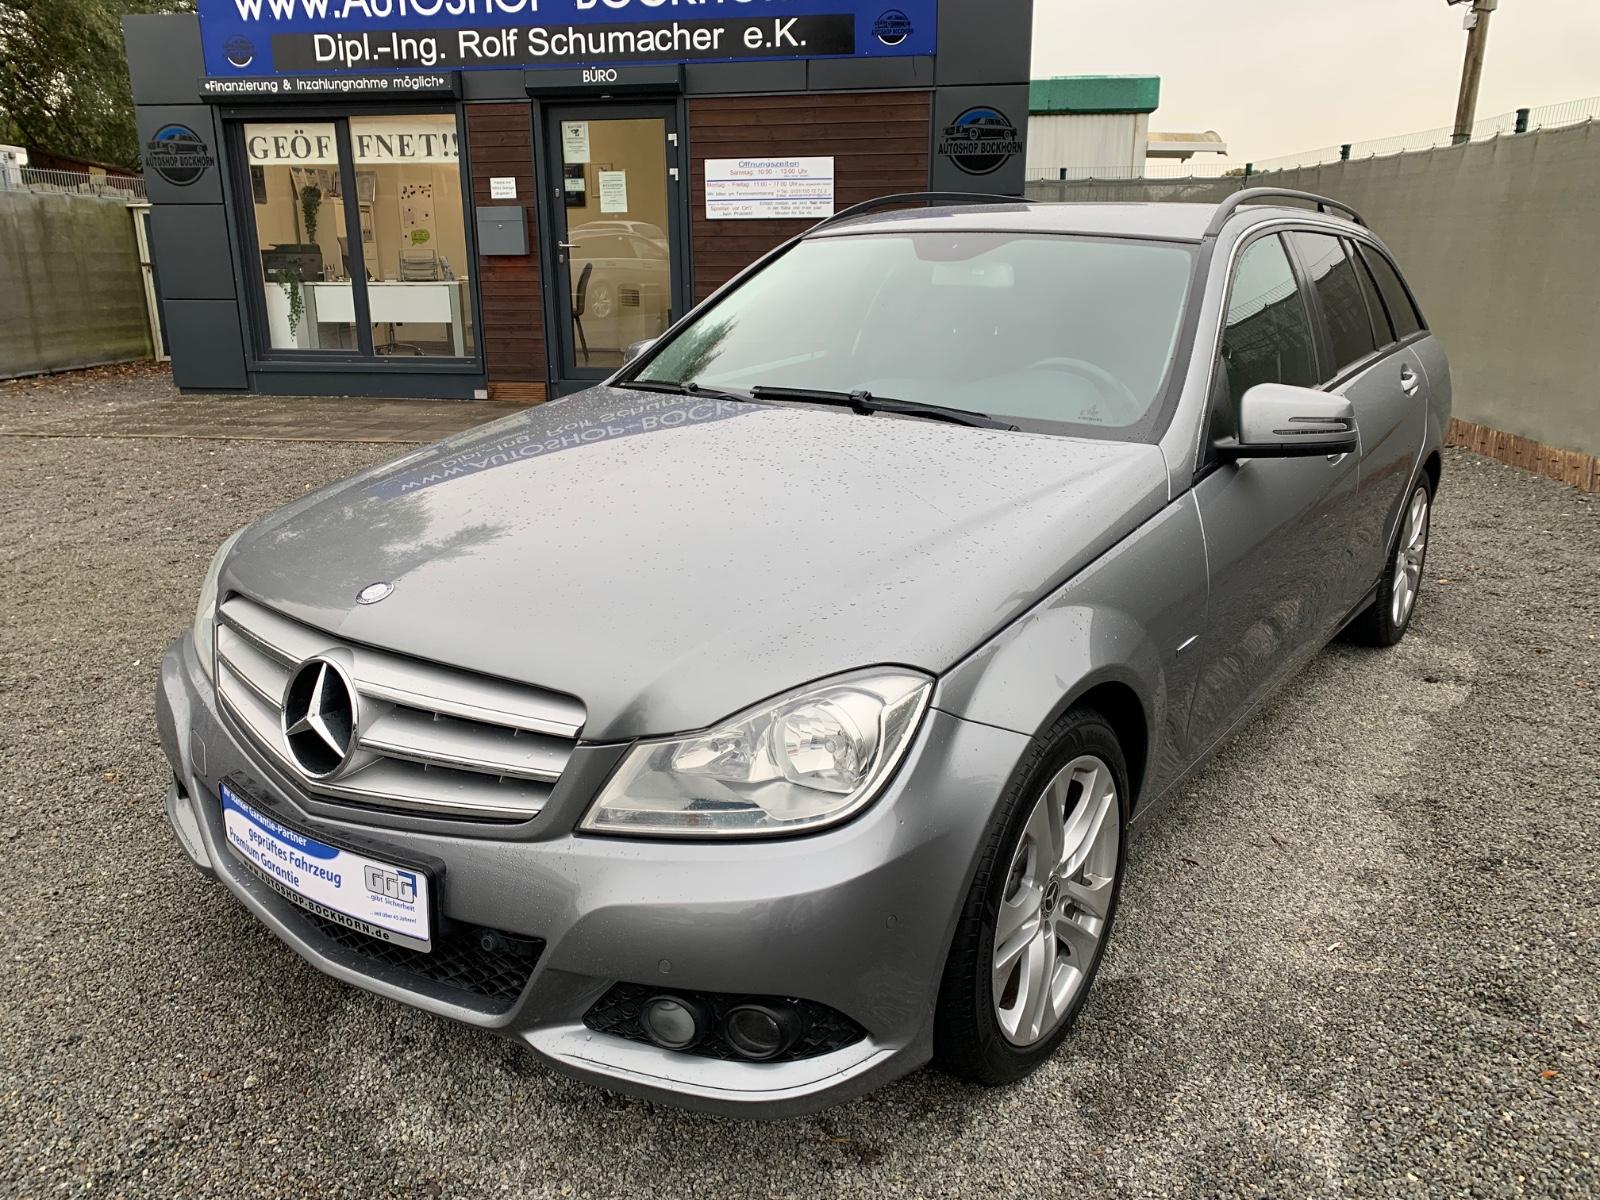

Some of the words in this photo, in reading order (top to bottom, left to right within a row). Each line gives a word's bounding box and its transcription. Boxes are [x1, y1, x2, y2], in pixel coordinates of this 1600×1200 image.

[314, 32, 446, 68] Dipl.-Ing.
[458, 28, 518, 59] Rolf
[528, 22, 724, 56] Schumacher
[743, 18, 807, 48] e.K.
[583, 66, 617, 82] BÜRO
[209, 80, 278, 93] Finanzierung
[283, 80, 292, 90] &
[297, 77, 388, 92] Inzahlungnahme
[393, 76, 439, 90] möglich
[938, 142, 978, 154] AUTOSHOP
[981, 141, 1023, 153] BOCKHORN
[145, 156, 178, 167] AUTOSHOP
[180, 155, 215, 167] BOCKHORN
[249, 806, 307, 847] Garantie-Partner
[229, 826, 260, 862] Premium
[260, 853, 300, 887] Garantie
[248, 828, 288, 861] geprüftes
[290, 851, 342, 889] Fahrzeug
[385, 897, 416, 912] Sicherheit
